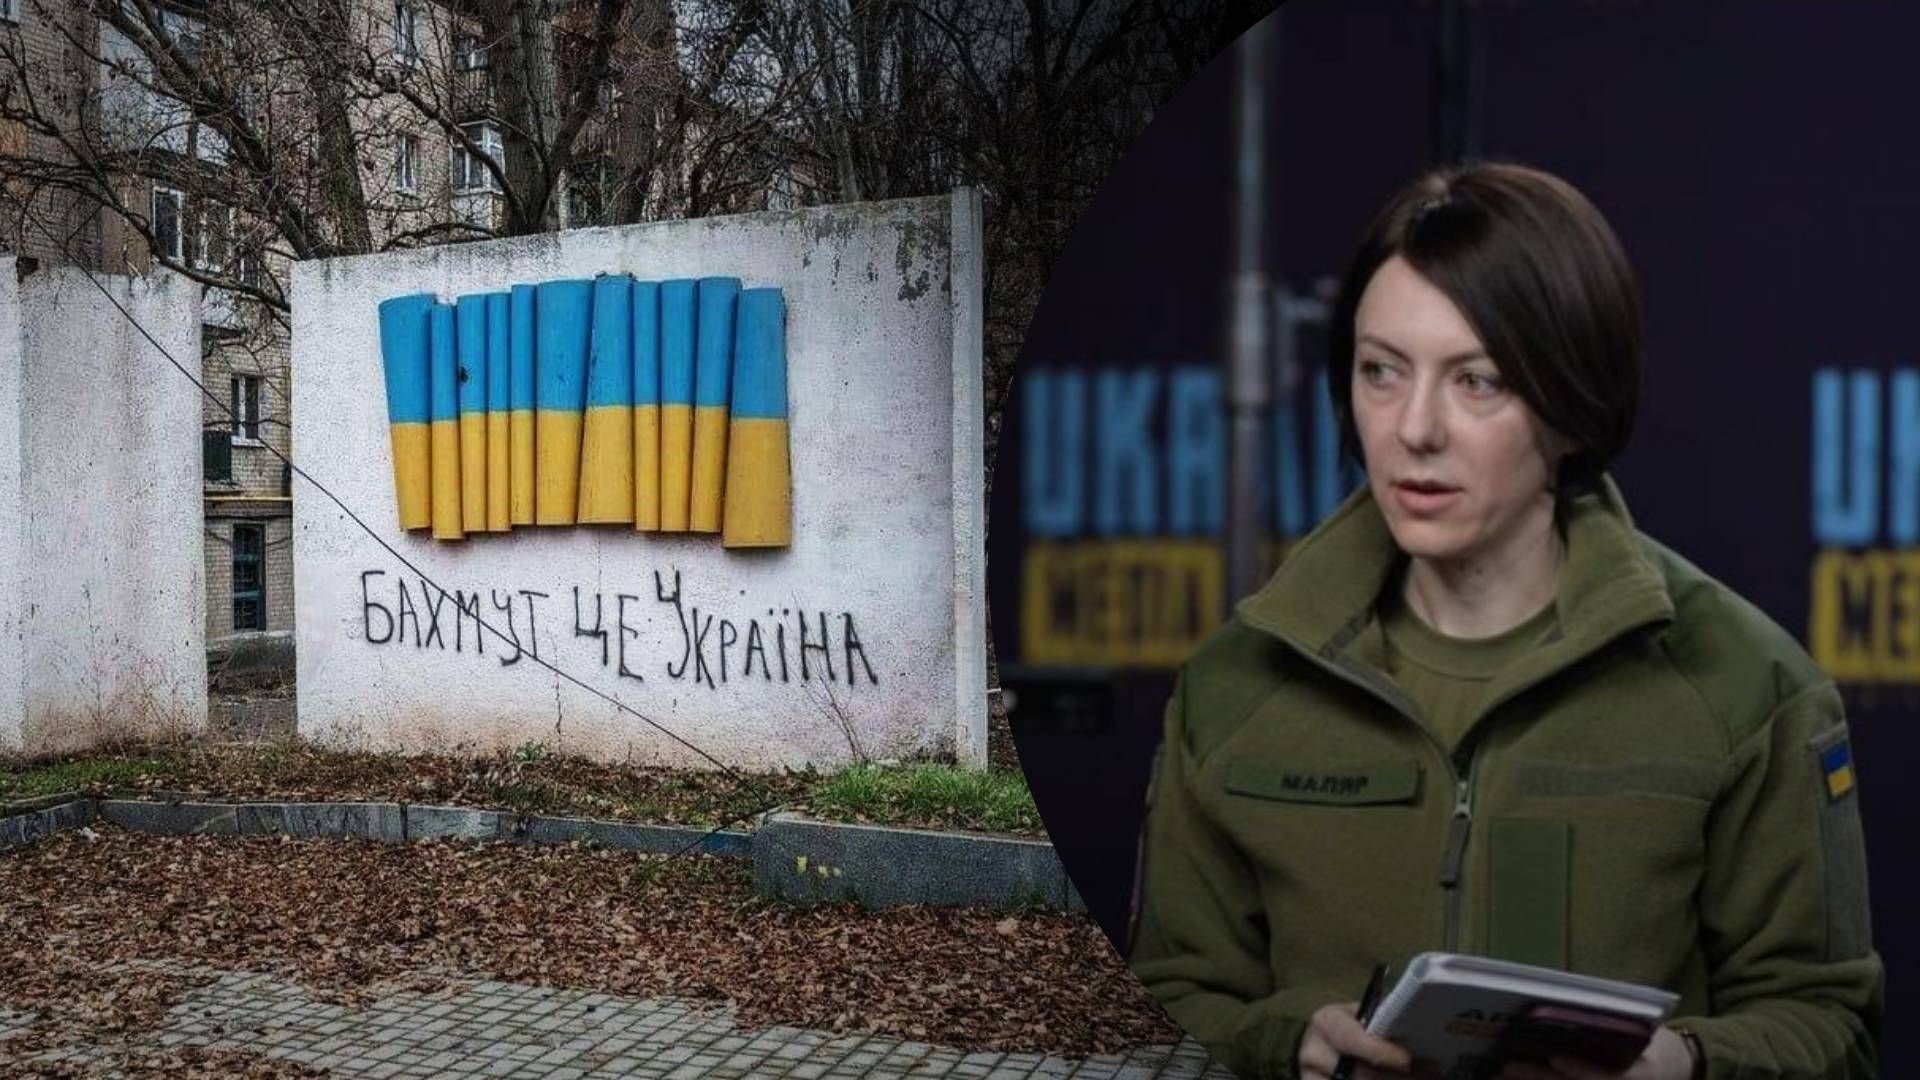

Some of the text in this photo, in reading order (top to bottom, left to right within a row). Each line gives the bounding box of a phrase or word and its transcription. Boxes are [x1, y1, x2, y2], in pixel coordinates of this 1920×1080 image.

[361, 568, 879, 690] БАХМУТ ЦЕ УКРАЇНА
[1280, 775, 1369, 794] МАЛЯР
